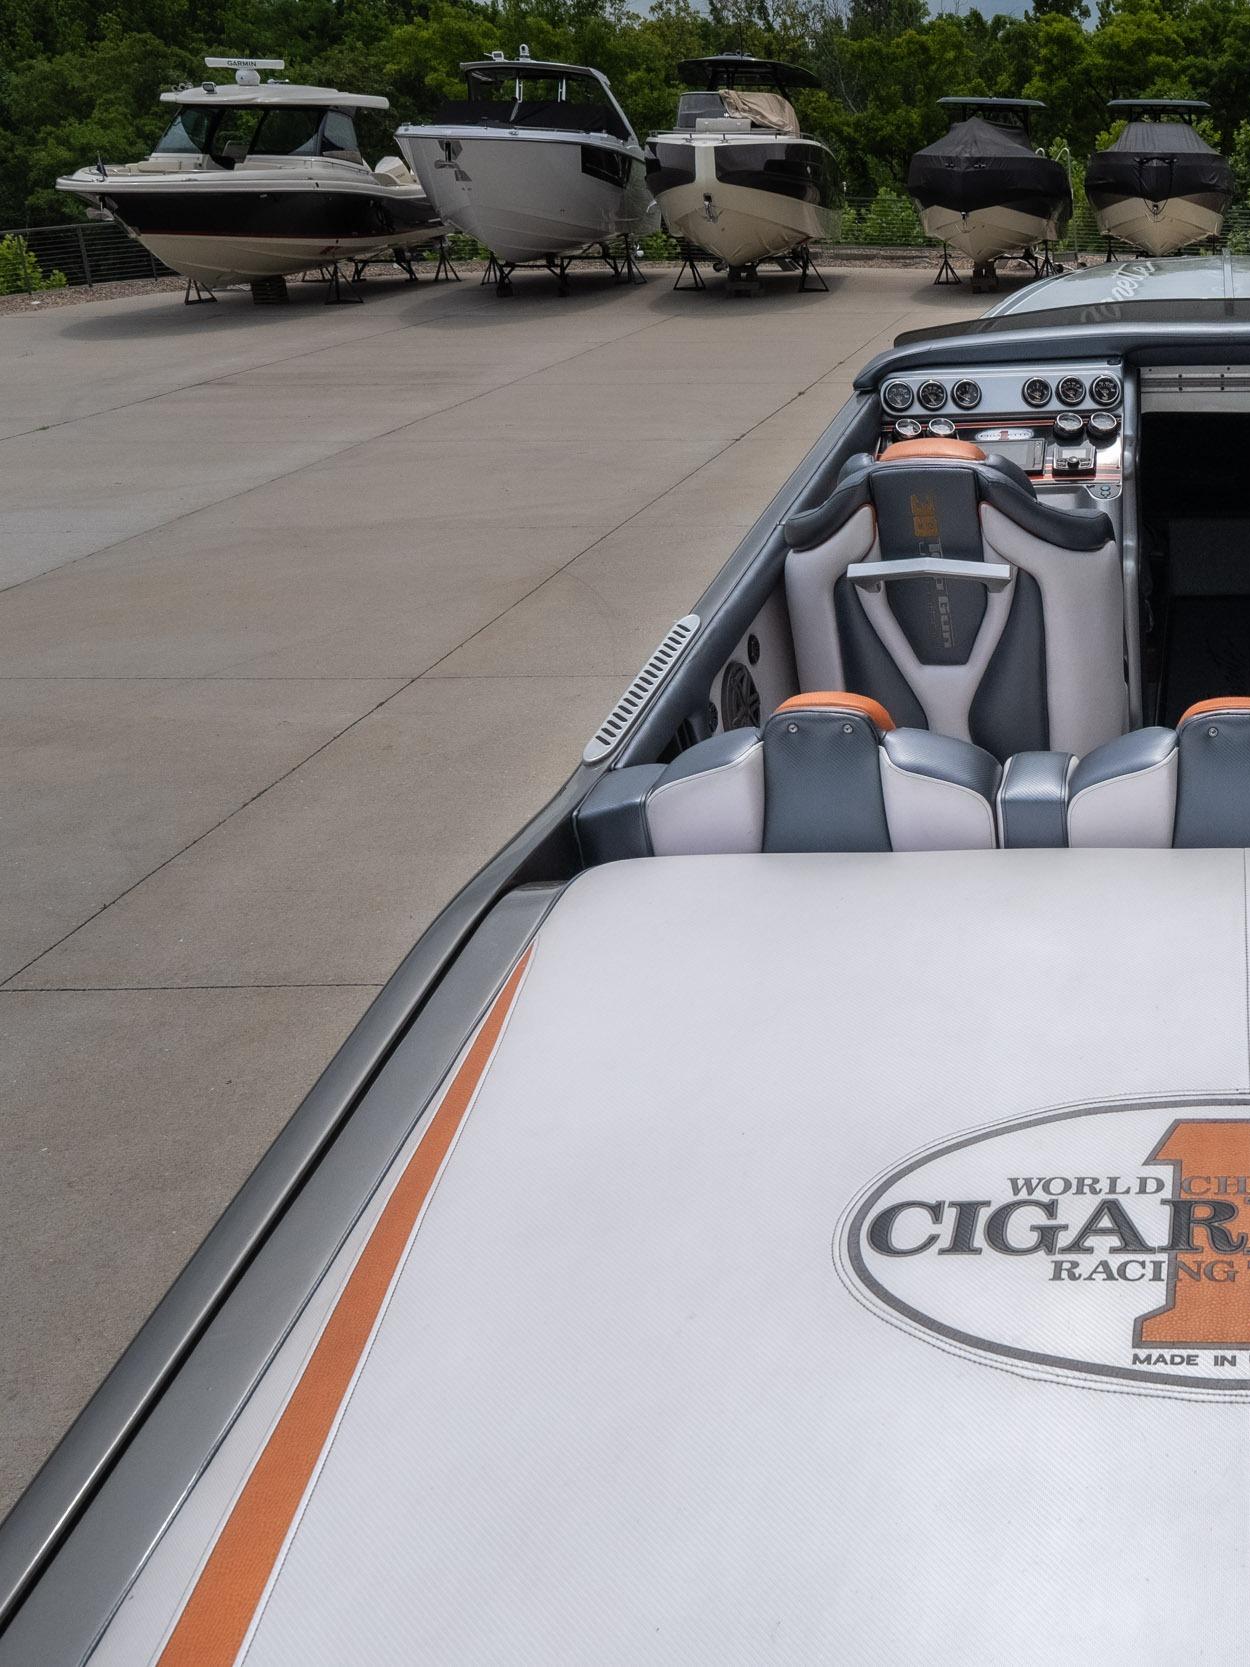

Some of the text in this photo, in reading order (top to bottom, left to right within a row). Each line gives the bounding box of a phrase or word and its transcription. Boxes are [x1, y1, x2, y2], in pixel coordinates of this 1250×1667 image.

[1008, 1176, 1165, 1196] WORLD
[1049, 1259, 1240, 1282] RACING
[1131, 1353, 1199, 1367] MADE
[1212, 1354, 1237, 1367] IN
